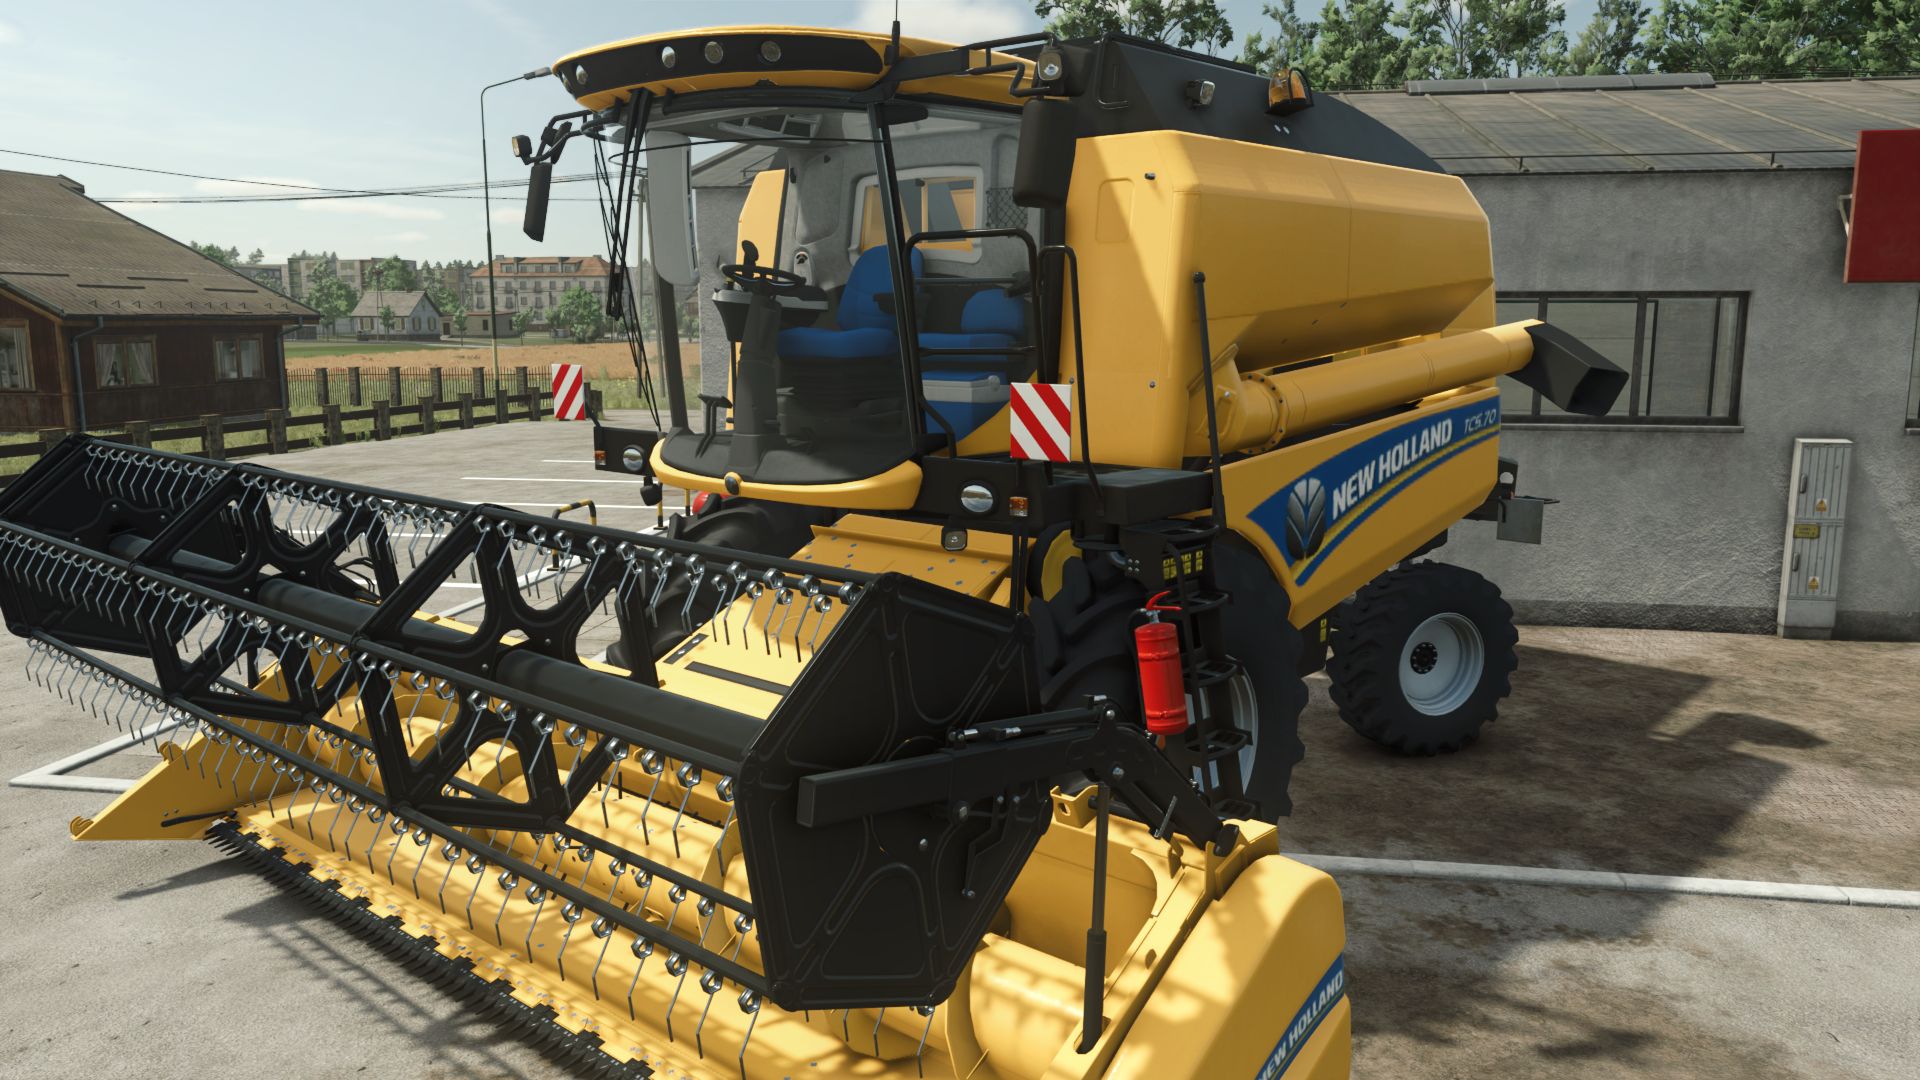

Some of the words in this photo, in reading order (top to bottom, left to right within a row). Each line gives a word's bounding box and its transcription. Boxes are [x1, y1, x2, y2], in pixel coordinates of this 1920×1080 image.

[1463, 408, 1497, 434] TC5.70
[1332, 460, 1376, 520] NEW
[1378, 418, 1453, 484] HOLLAND
[1288, 969, 1344, 1049] HOLLAND
